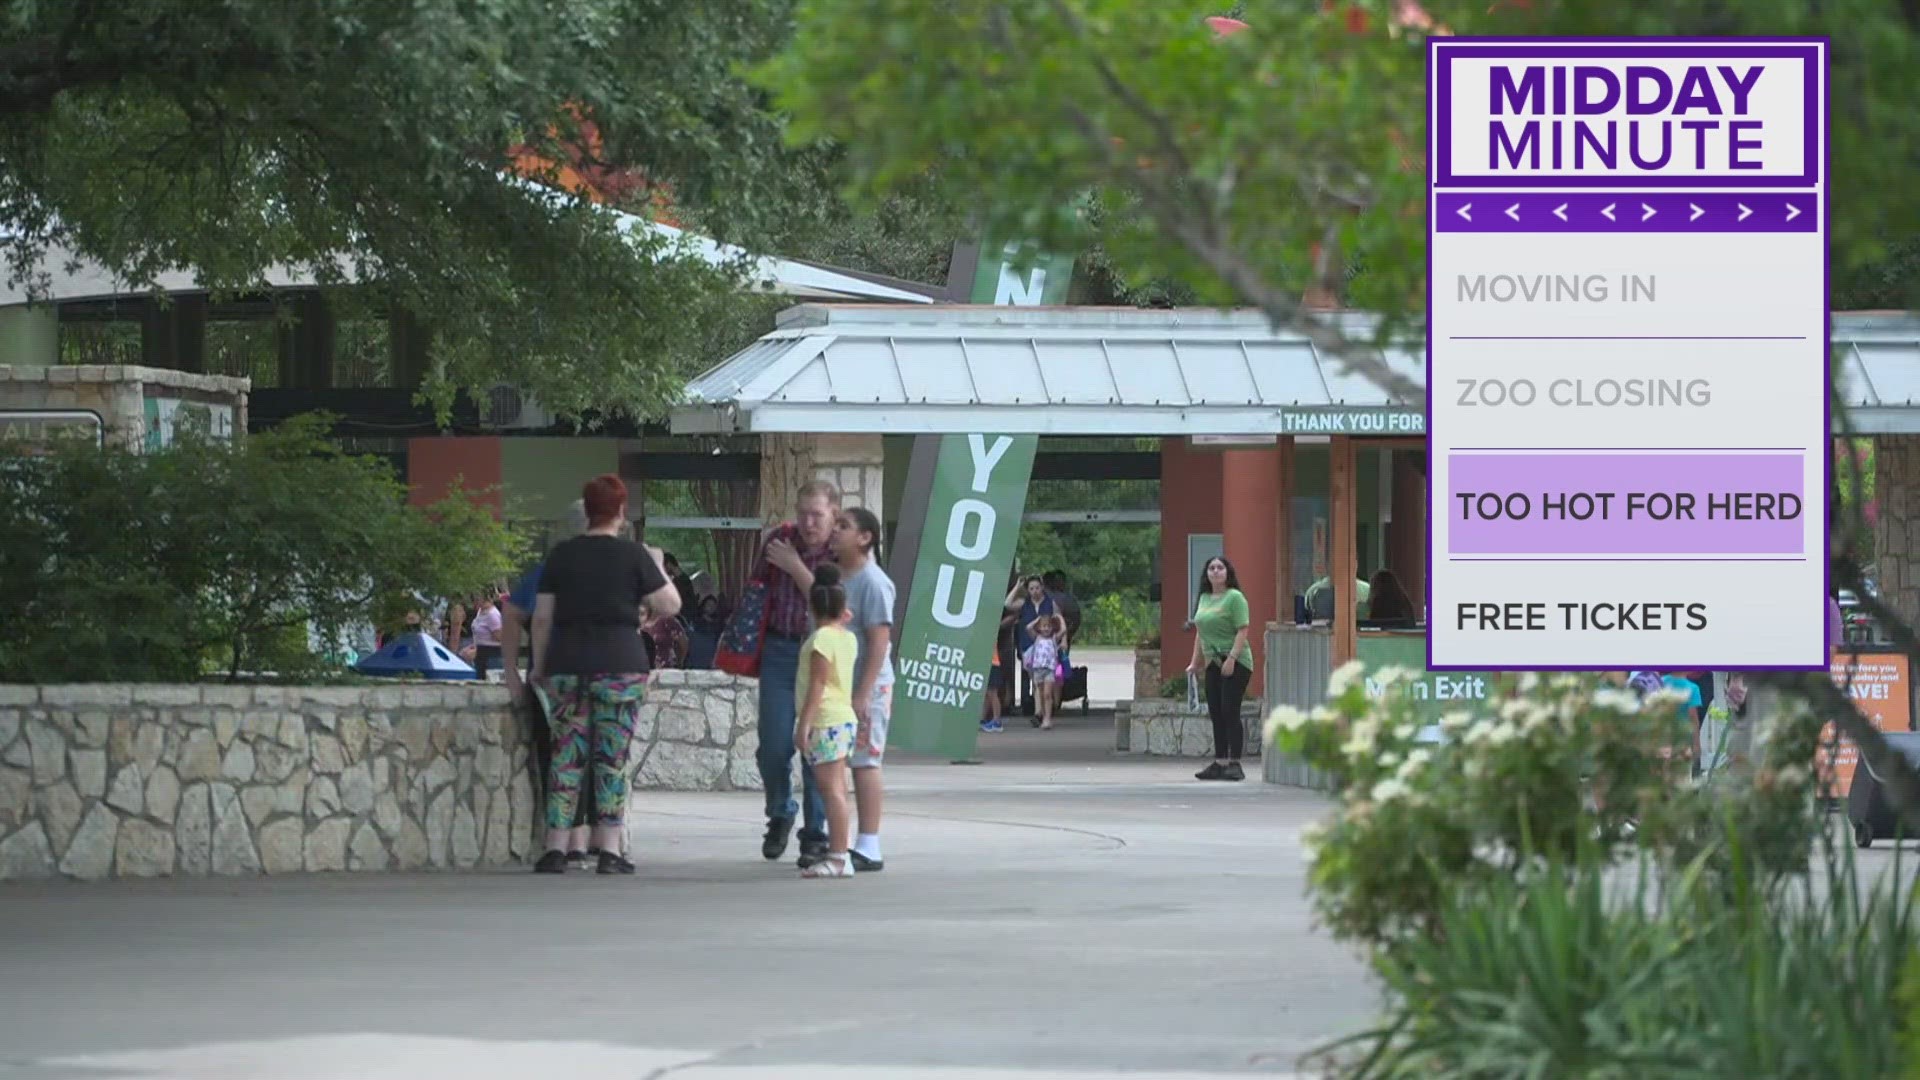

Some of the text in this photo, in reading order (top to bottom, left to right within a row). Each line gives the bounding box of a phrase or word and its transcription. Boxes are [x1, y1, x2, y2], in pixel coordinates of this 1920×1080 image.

[3, 422, 91, 440] ALLAS
[1284, 412, 1423, 431] THANK YOU FOR
[932, 434, 1014, 628] YOU
[925, 643, 965, 667] FOR
[899, 657, 984, 691] VISITING
[906, 679, 970, 708] TODAY
[1365, 676, 1485, 700] Mn Exit
[1848, 683, 1889, 699] AVE!
